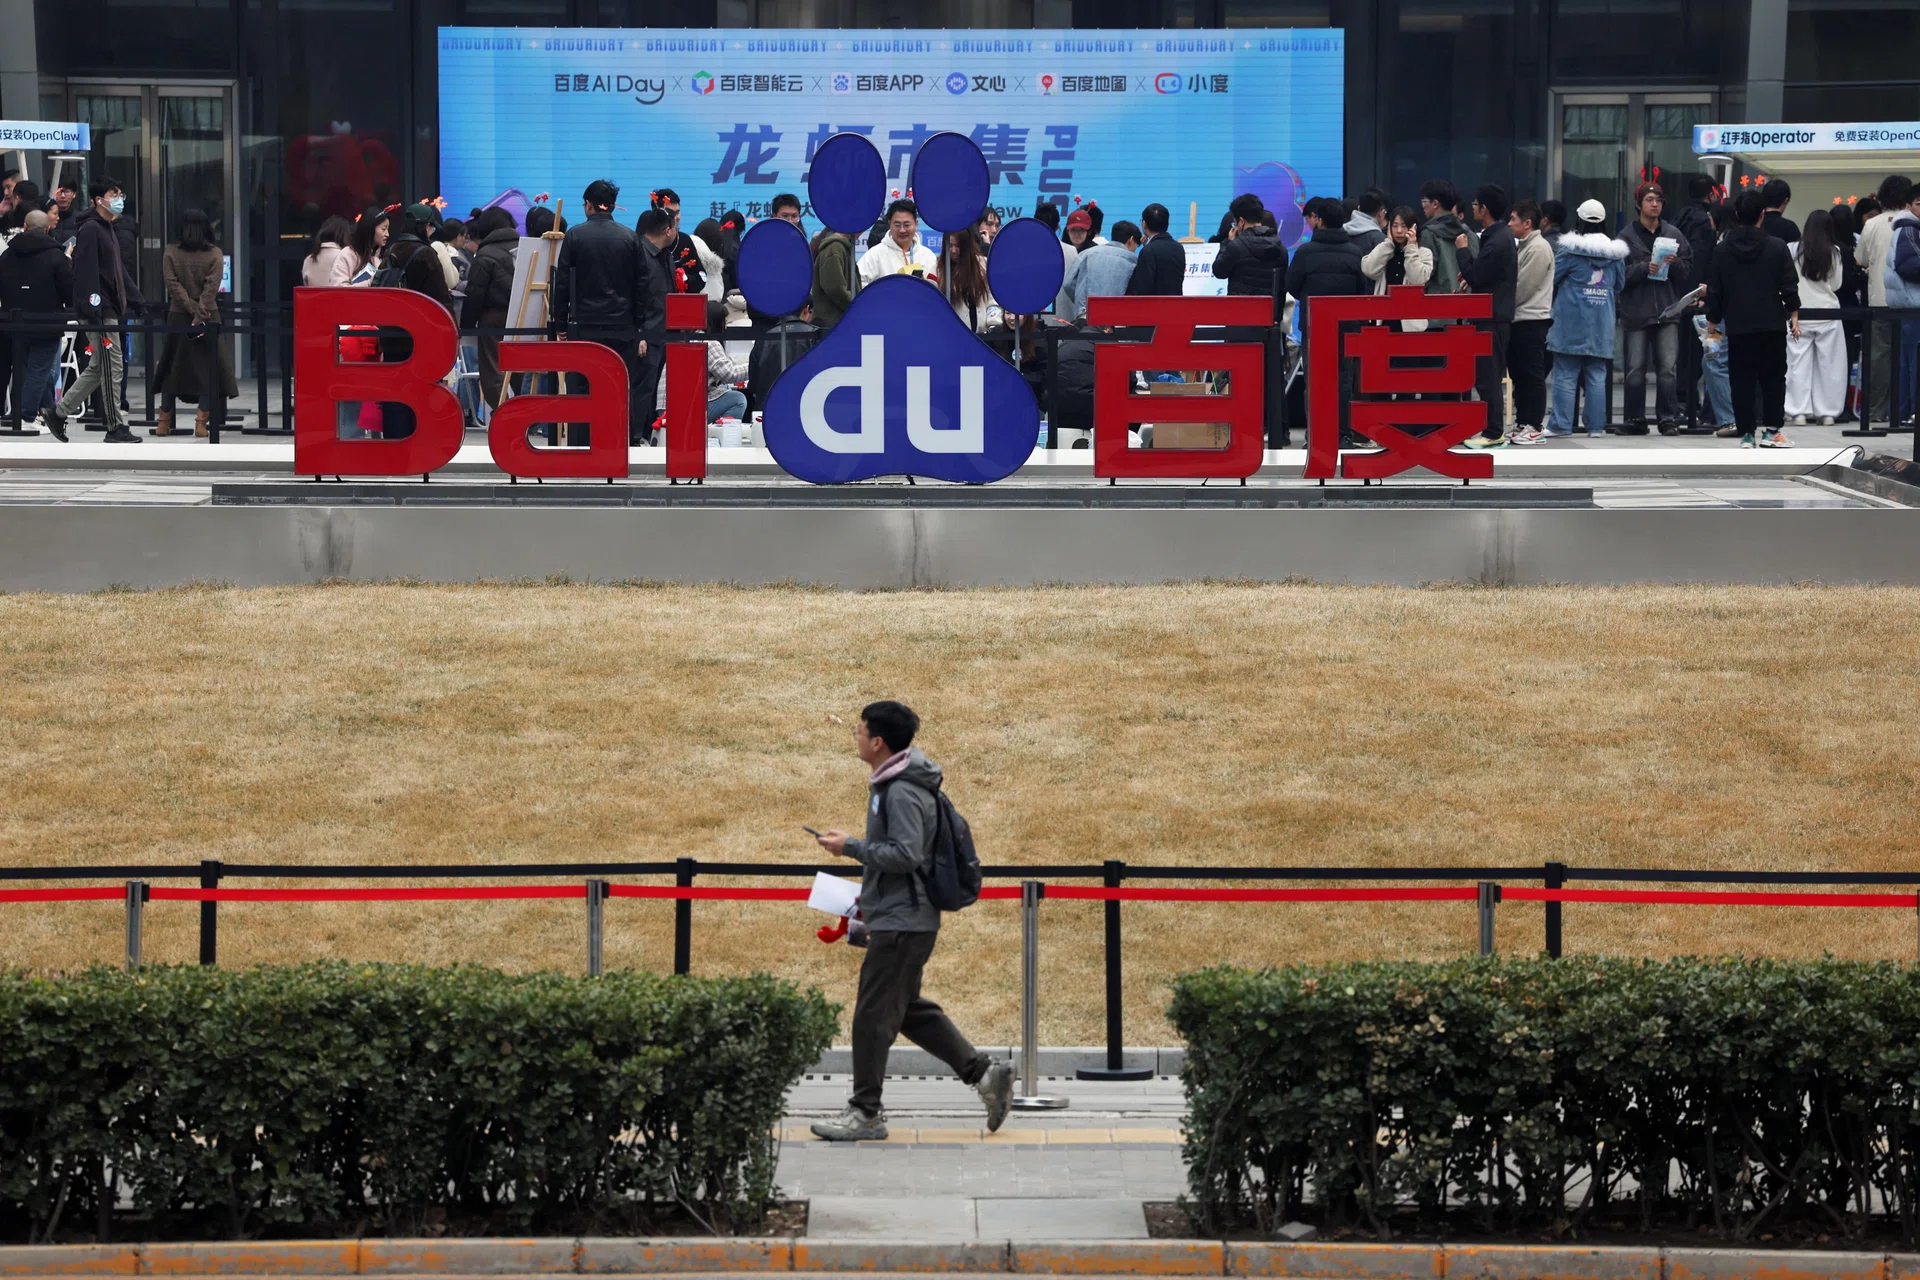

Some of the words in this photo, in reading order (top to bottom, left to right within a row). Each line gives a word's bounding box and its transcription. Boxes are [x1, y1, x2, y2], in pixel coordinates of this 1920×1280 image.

[617, 75, 665, 105] Day
[720, 74, 803, 92] 百度智能云
[856, 74, 924, 92] 百度APP
[971, 74, 1006, 92] 文心
[1062, 75, 1127, 92] 百度地图
[1188, 74, 1229, 93] 小度
[0, 129, 80, 142] 安装OpenClaw
[1721, 130, 1816, 148] 红手指Operator
[294, 286, 708, 478] Bai
[800, 334, 984, 453] du
[1087, 285, 1494, 479] 百度
